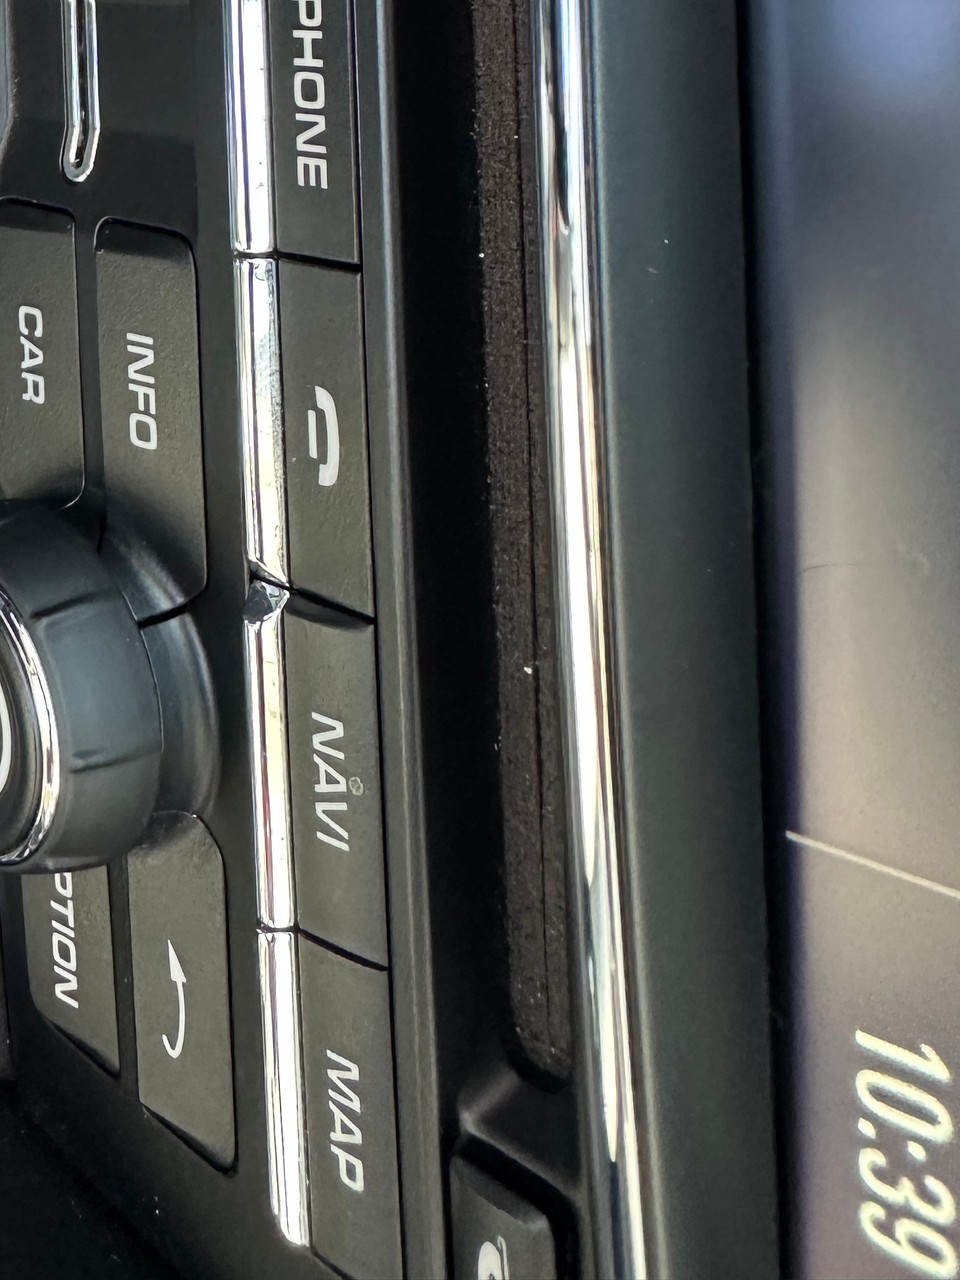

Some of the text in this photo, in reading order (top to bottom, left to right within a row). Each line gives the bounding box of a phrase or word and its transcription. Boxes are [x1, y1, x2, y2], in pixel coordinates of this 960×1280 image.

[17, 305, 46, 406] CAR
[125, 332, 160, 452] INFO
[311, 711, 351, 852] NAVI
[50, 871, 80, 1010] PTION
[325, 1049, 364, 1193] MAP
[855, 1029, 958, 1279] 10:39
